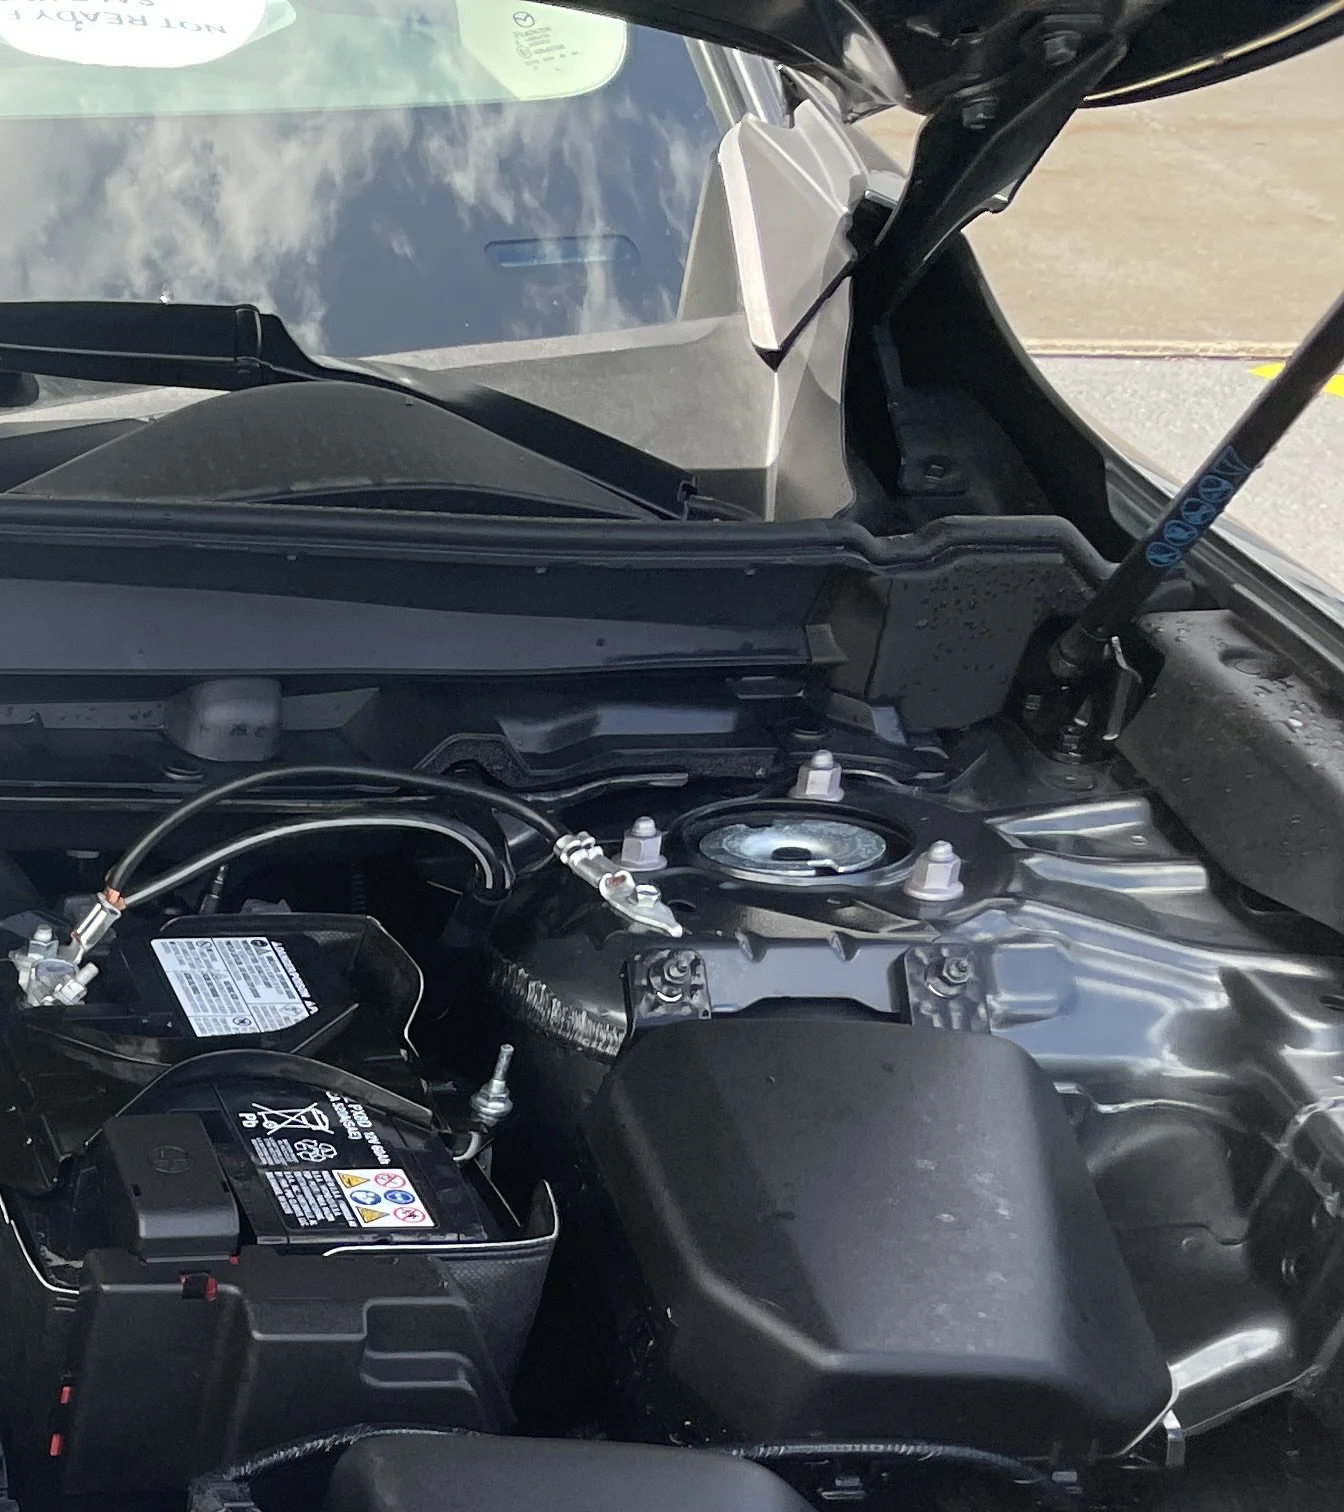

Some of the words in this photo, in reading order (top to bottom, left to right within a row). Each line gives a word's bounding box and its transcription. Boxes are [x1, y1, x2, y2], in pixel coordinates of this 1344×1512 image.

[36, 9, 148, 27] READY
[161, 16, 228, 34] NOT
[239, 1112, 258, 1128] Pb
